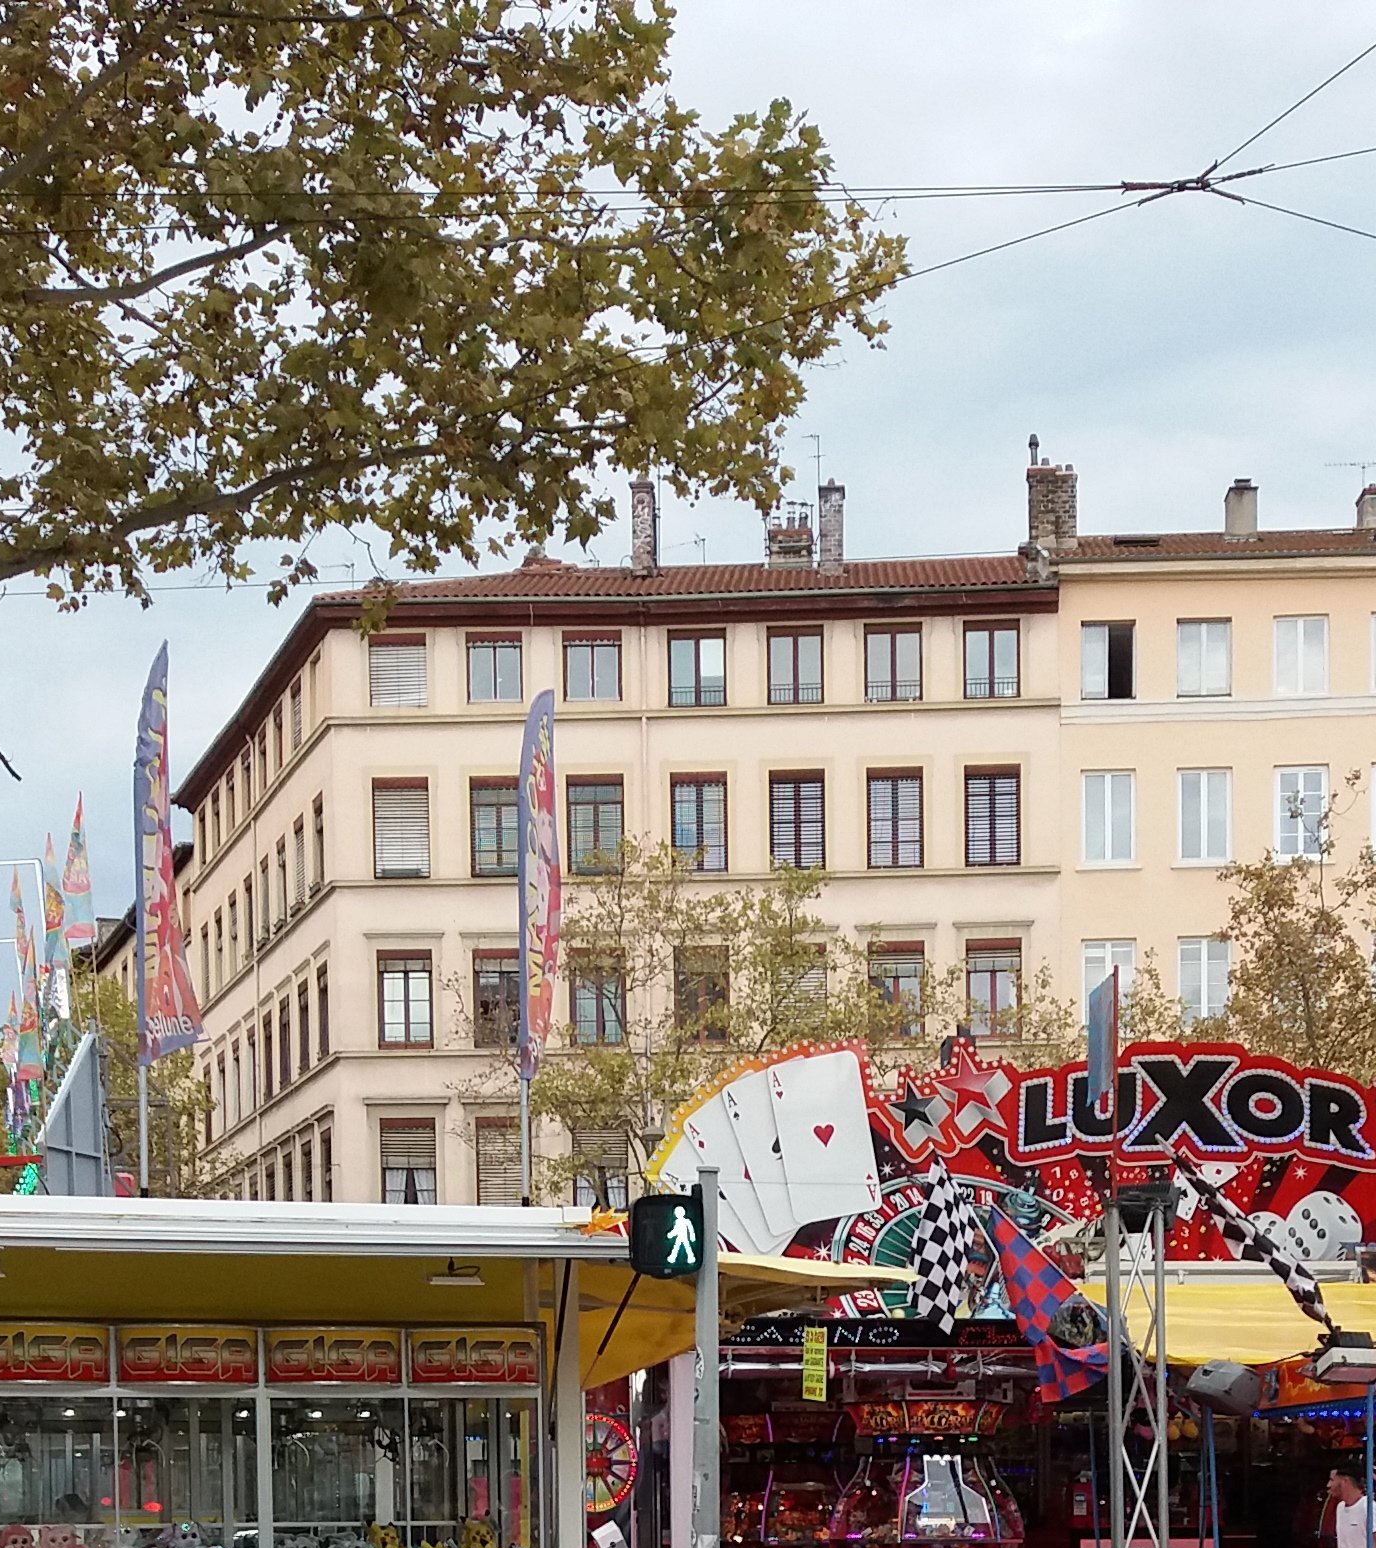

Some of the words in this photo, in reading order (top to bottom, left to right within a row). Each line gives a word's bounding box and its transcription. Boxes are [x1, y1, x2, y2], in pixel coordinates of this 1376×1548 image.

[1018, 1055, 1376, 1159] LUXOR
[889, 1191, 909, 1211] 20
[906, 1187, 922, 1203] 14
[855, 1222, 875, 1239] 16
[849, 1236, 871, 1257] 24
[856, 1290, 875, 1307] 23
